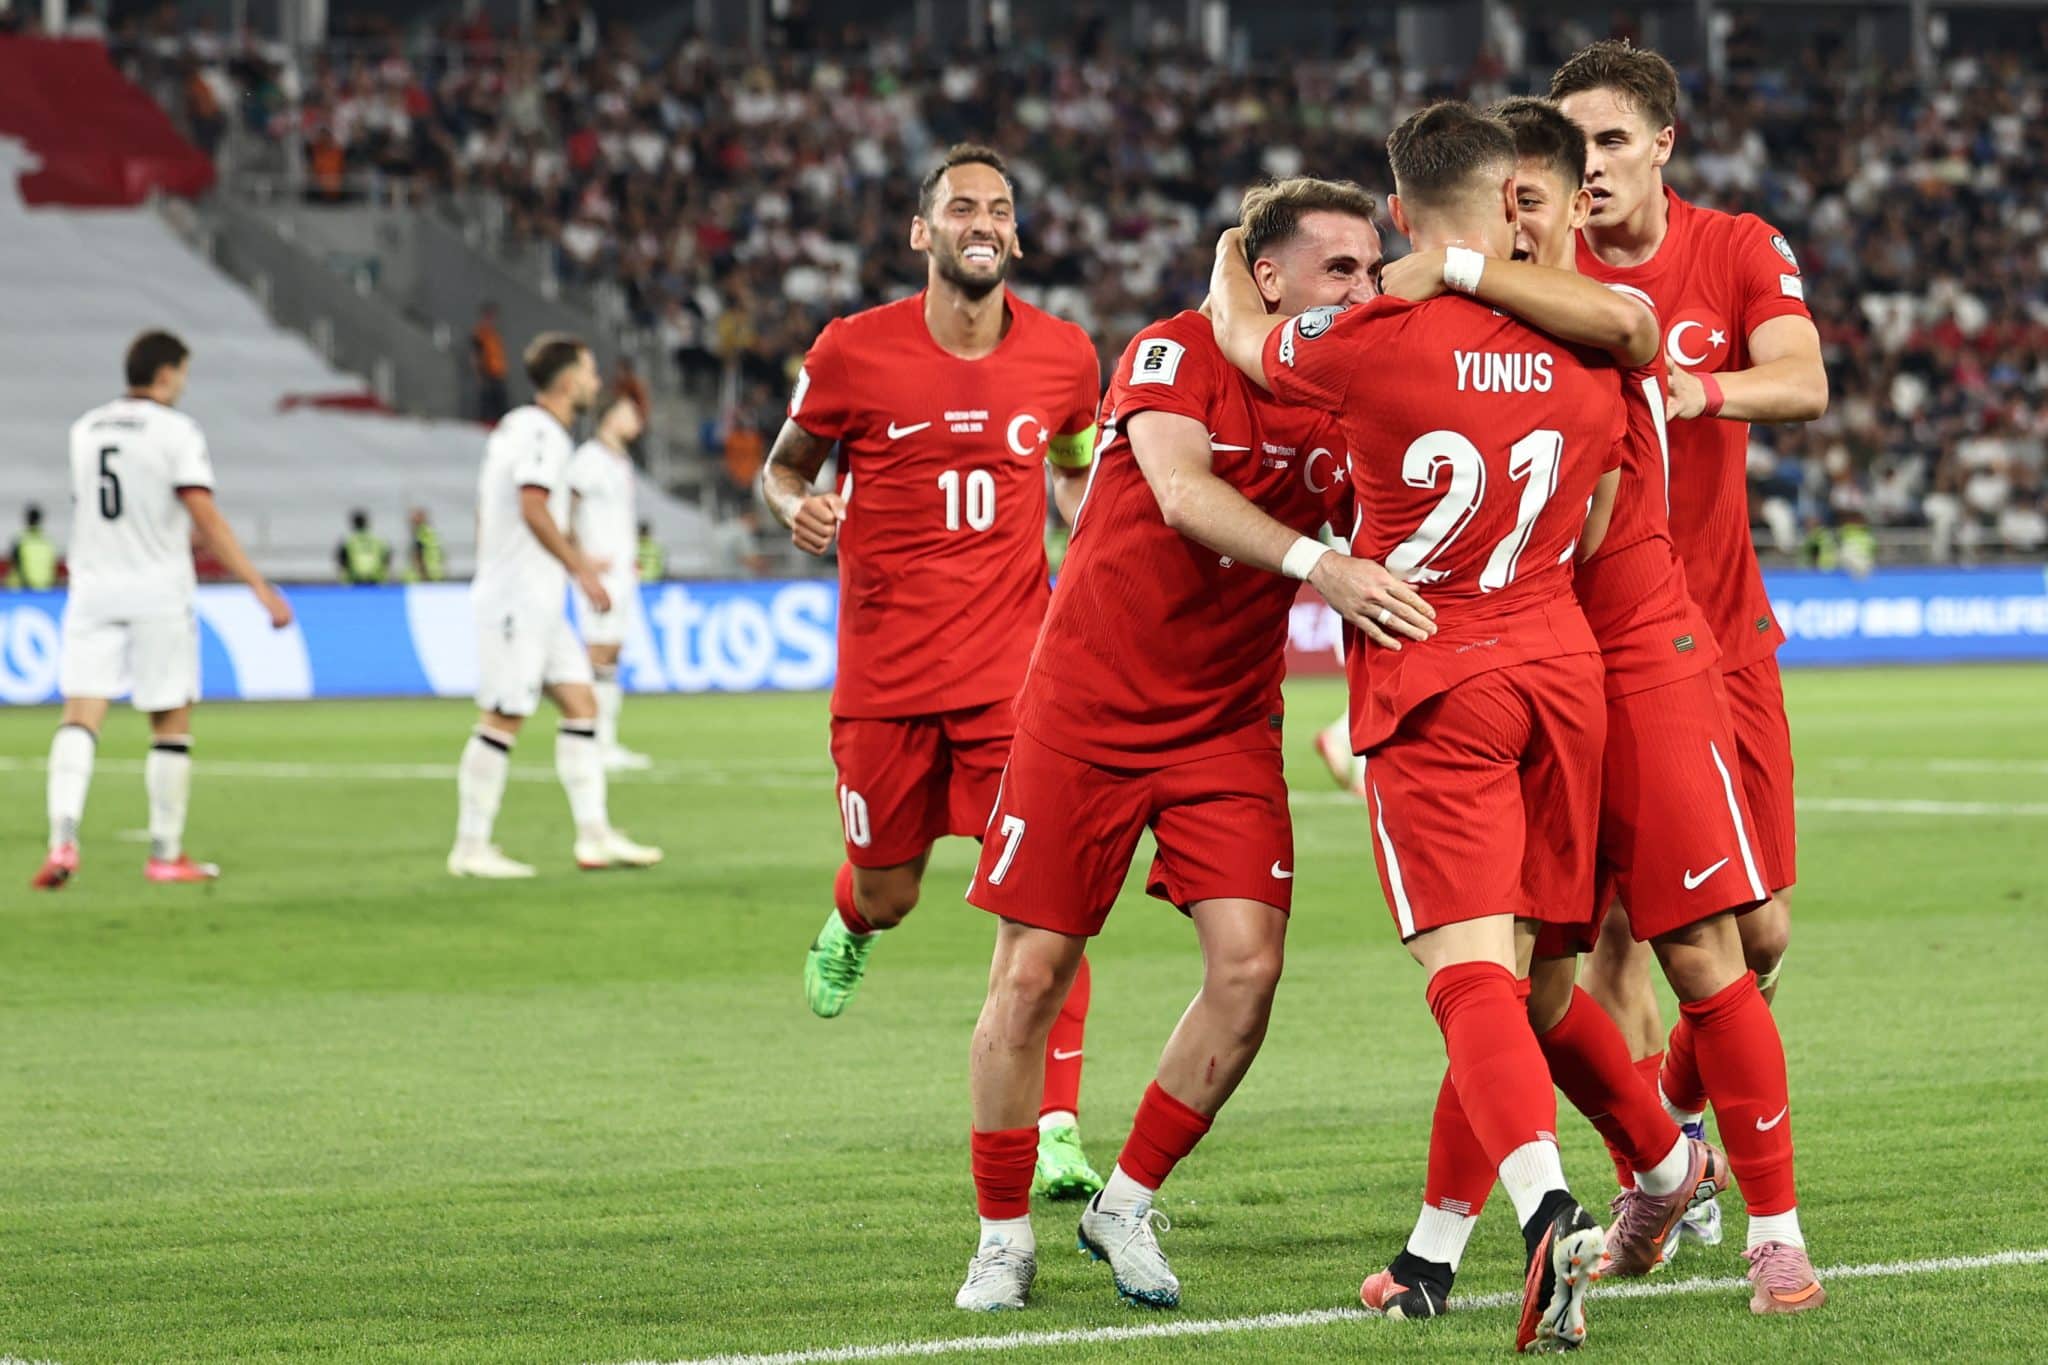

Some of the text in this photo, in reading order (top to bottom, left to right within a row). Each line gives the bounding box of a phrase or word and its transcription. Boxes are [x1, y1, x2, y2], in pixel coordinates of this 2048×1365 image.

[1453, 350, 1553, 393] YUNUS
[100, 446, 122, 520] 5
[937, 468, 996, 532] 10
[1384, 429, 1564, 593] 21
[840, 784, 872, 848] 10
[988, 814, 1026, 885] 7
